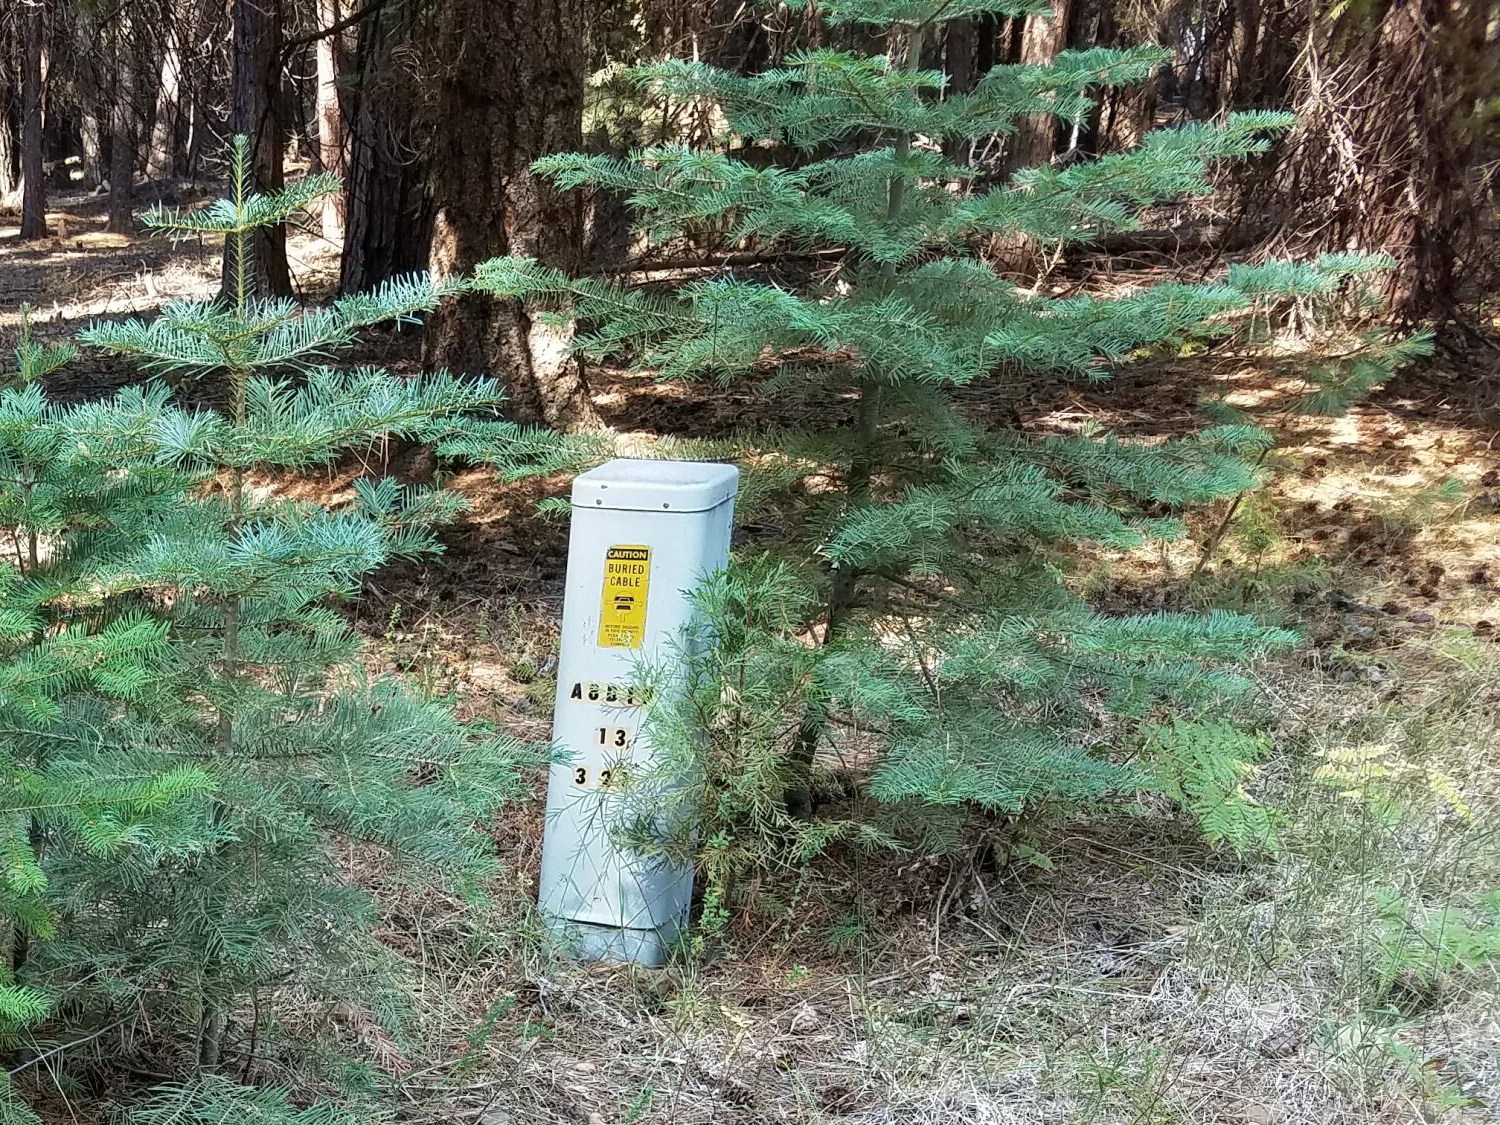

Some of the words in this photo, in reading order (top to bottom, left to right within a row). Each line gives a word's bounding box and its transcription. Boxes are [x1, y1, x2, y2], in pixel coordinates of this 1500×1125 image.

[607, 550, 647, 559] CAUTION
[608, 563, 645, 575] BURIED
[610, 576, 641, 588] CABLE
[599, 727, 626, 747] 13
[575, 767, 586, 785] 3
